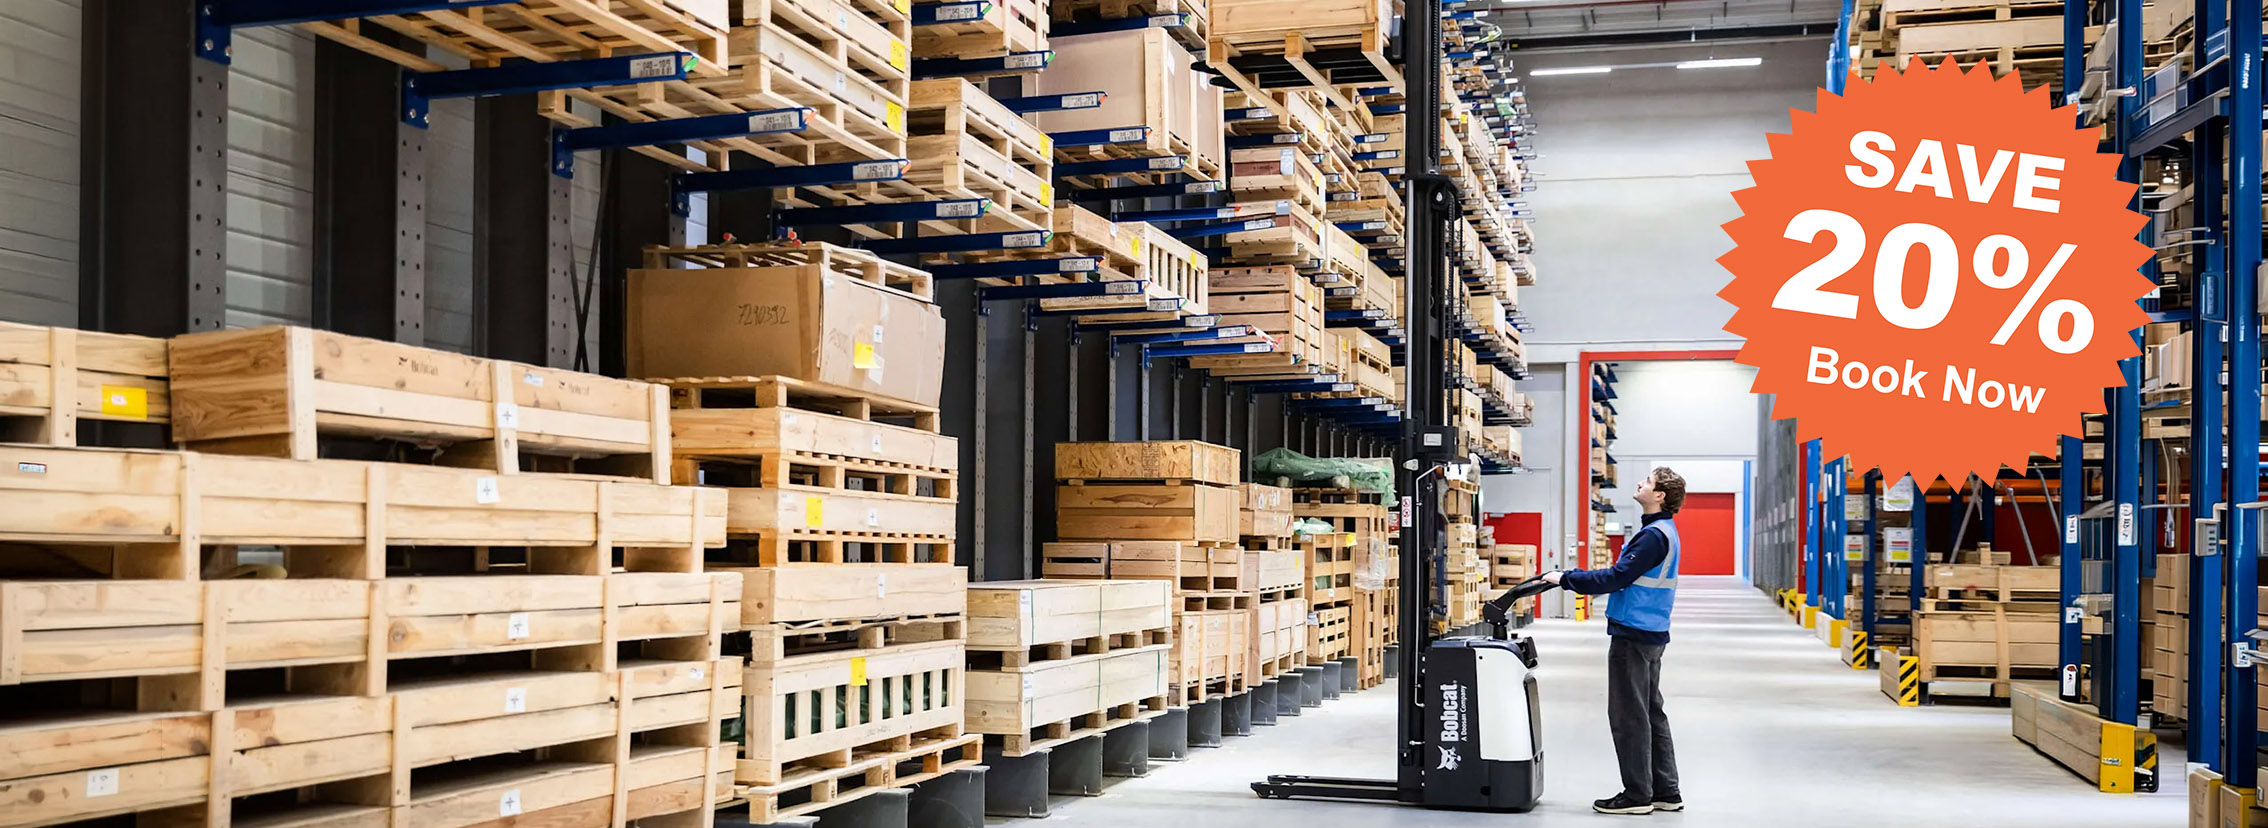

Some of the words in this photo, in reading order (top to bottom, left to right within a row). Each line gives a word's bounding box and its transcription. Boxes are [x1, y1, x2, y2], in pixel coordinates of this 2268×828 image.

[1440, 683, 1460, 742] Bobcat
[1459, 684, 1468, 713] Company
[1460, 713, 1468, 736] Doosan
